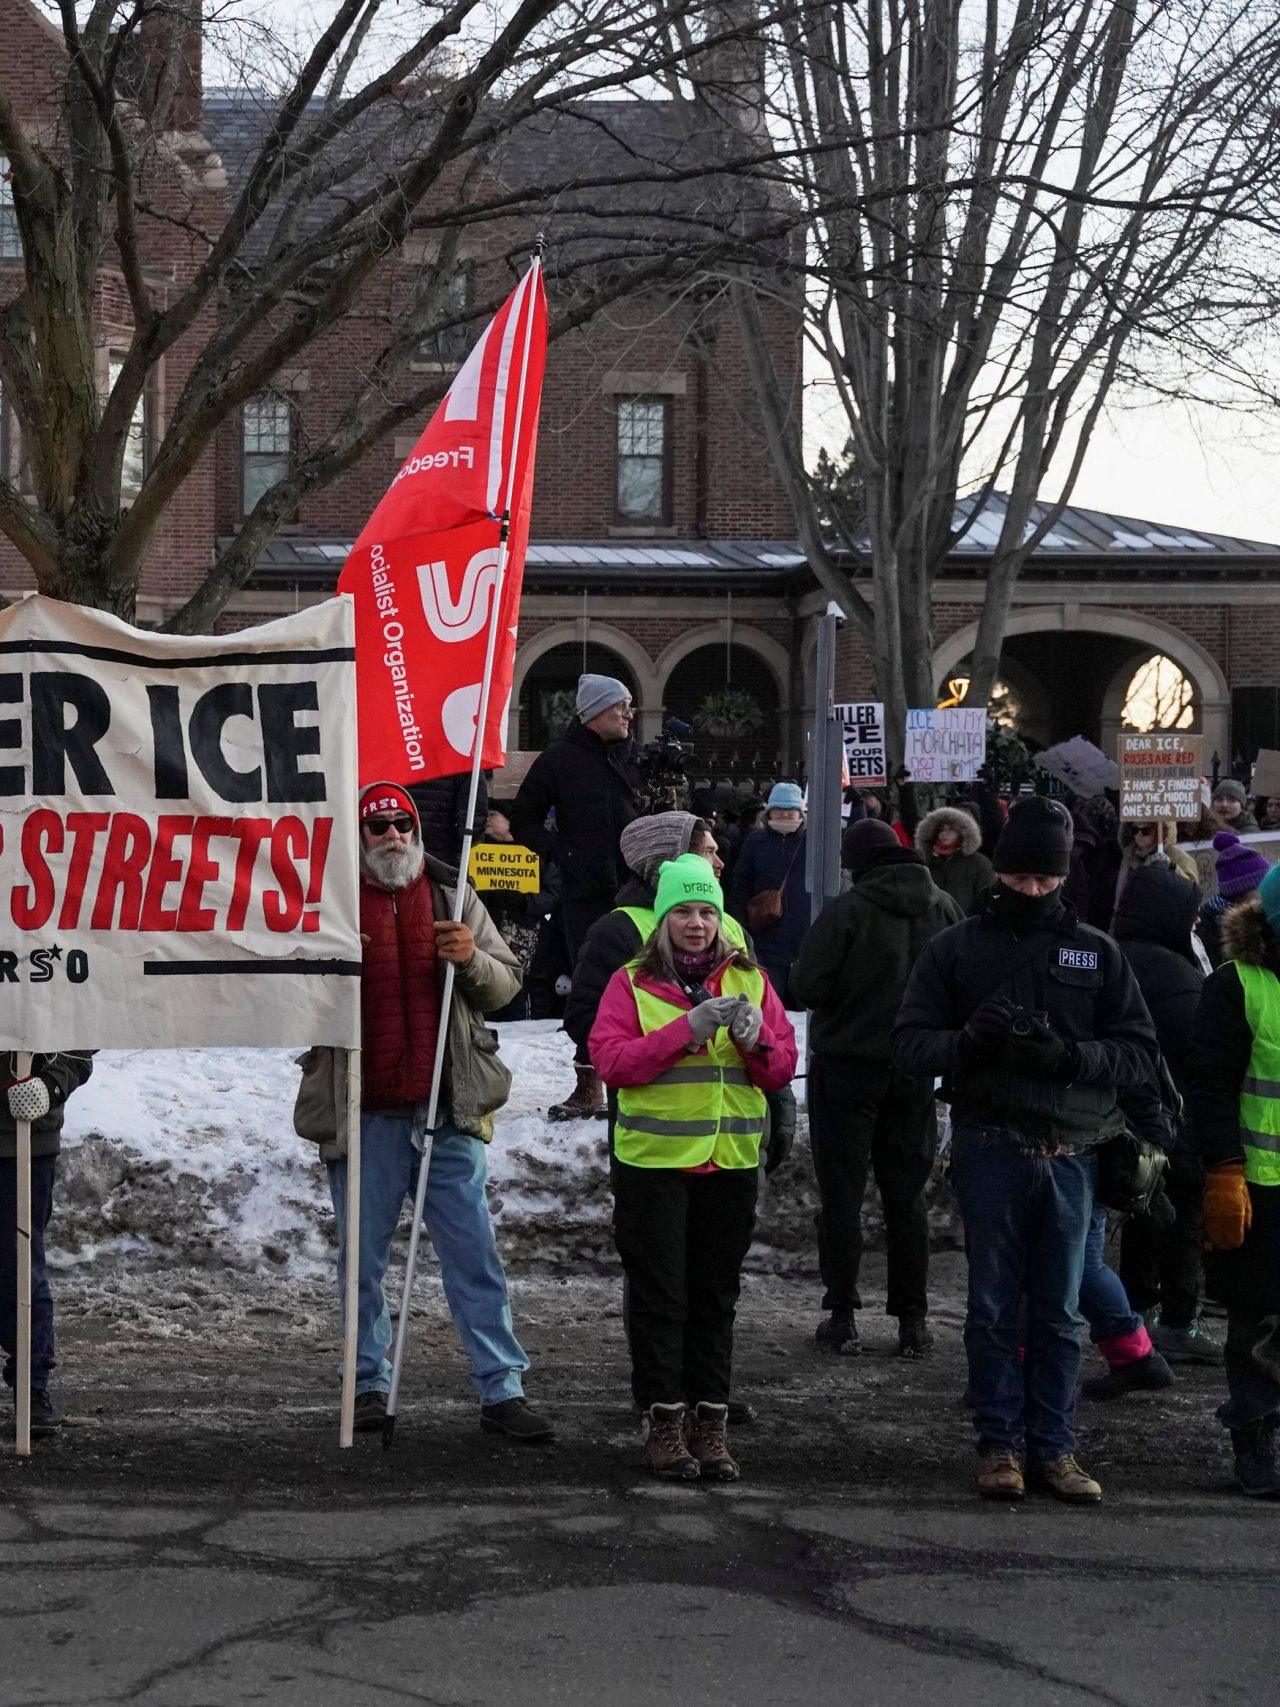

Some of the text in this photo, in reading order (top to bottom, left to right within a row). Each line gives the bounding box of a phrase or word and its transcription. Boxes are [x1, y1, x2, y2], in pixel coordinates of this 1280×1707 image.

[370, 544, 426, 771] ocialist Organization
[908, 708, 984, 731] ICE IN MY
[146, 681, 327, 804] ICE
[913, 730, 983, 756] HORCHATA
[1126, 737, 1185, 753] DEAR ICE,
[851, 748, 883, 757] OUR
[1123, 752, 1195, 765] ROSES ARE RED
[847, 756, 884, 777] EETS
[1123, 780, 1131, 791] I
[1133, 780, 1155, 791] HAVE
[1157, 780, 1166, 793] 5
[1123, 791, 1195, 803] AND THE MIDDLE
[363, 797, 398, 818] FRSO
[1122, 802, 1198, 818] ONE'S FOR YOU!
[475, 852, 539, 863] ICE OUT OF
[10, 808, 334, 933] STREETS!
[476, 866, 537, 878] MINNESOTA
[489, 879, 520, 889] NOW!
[1062, 950, 1095, 967] PRESS
